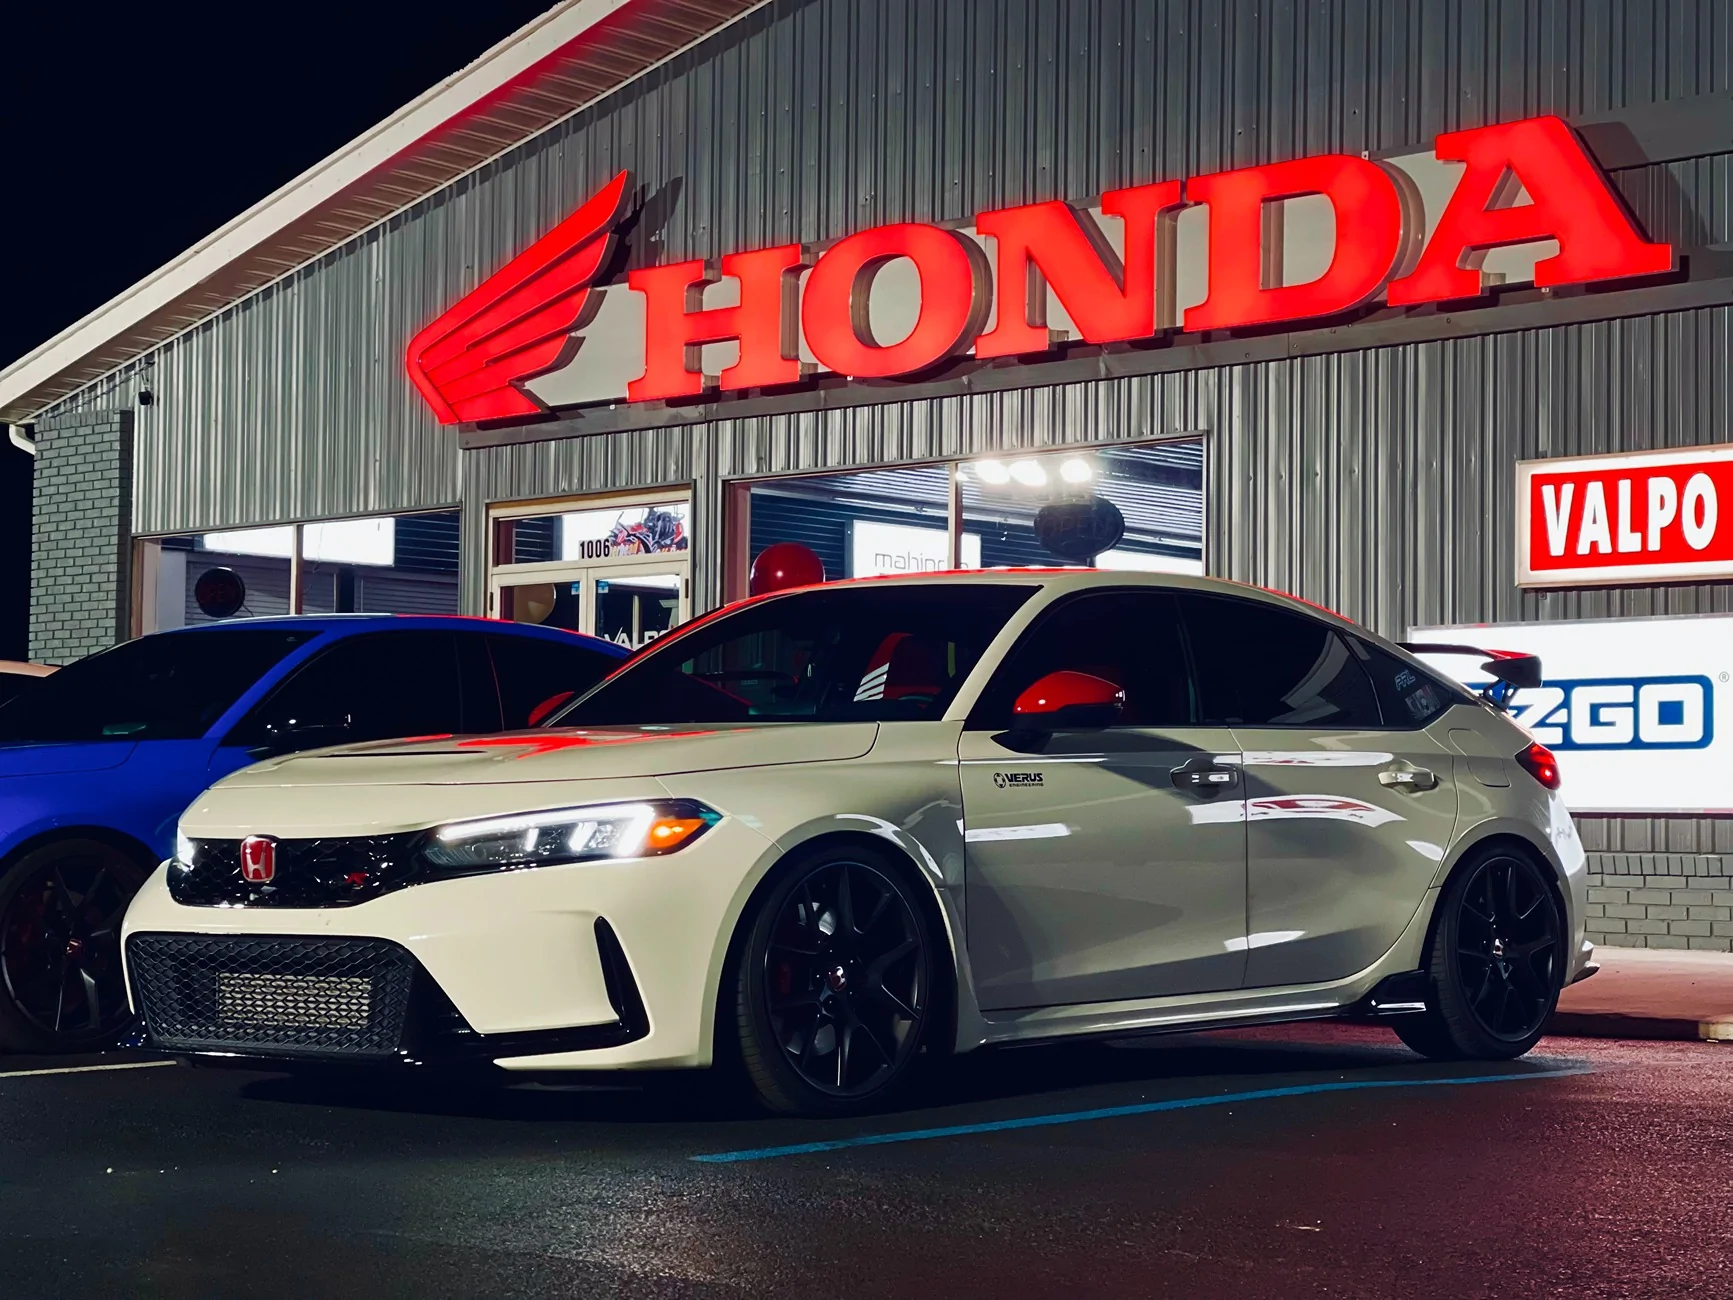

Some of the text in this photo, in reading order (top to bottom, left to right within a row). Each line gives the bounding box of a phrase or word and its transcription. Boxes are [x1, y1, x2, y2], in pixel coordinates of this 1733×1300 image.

[626, 115, 1674, 402] HONDA
[1542, 472, 1718, 557] VALPO
[580, 538, 611, 559] 1006
[875, 552, 968, 572] mahin
[604, 626, 669, 651] VALP
[1507, 682, 1704, 745] ZGO
[1005, 773, 1043, 782] VERUS
